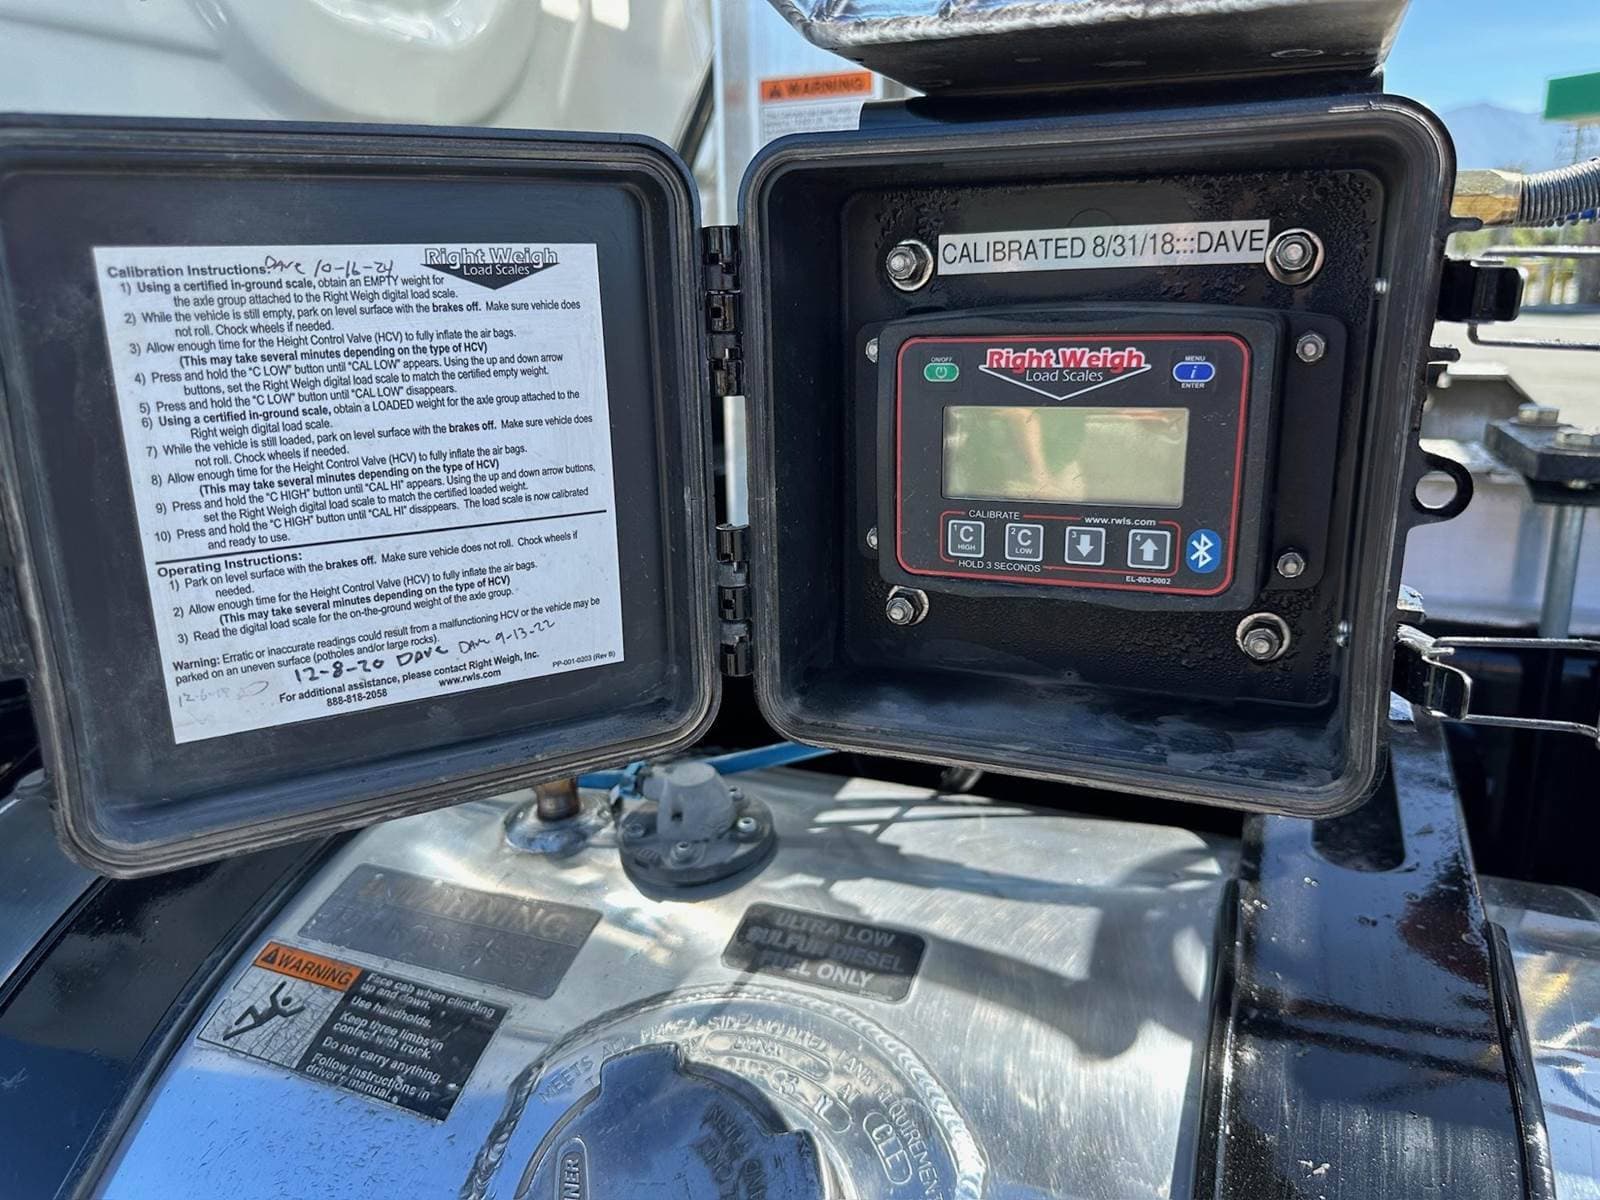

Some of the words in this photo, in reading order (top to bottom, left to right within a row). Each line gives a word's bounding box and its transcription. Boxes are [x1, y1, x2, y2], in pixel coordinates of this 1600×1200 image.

[788, 78, 864, 96] WARNING
[424, 247, 486, 269] Right
[489, 247, 559, 269] Weigh
[942, 237, 1086, 264] CALIBRATED
[106, 265, 184, 279] Calibration
[187, 262, 270, 277] Instructions:
[464, 264, 493, 276] Load
[496, 264, 530, 276] Scales
[173, 295, 191, 308] the
[192, 294, 215, 307] axle
[217, 296, 247, 309] group
[249, 292, 292, 305] attached
[293, 292, 304, 304] to
[305, 291, 321, 304] the
[323, 290, 349, 305] Right
[349, 289, 381, 304] Weigh
[381, 288, 409, 303] digital
[410, 288, 431, 300] load
[432, 288, 459, 299] scale.
[174, 325, 193, 337] not
[194, 324, 214, 337] roll.
[215, 323, 249, 336] Chock
[249, 321, 286, 334] wheels
[286, 321, 294, 333] if
[295, 319, 335, 333] needed.
[179, 354, 208, 370] (This
[209, 356, 233, 367] may
[234, 352, 258, 364] take
[260, 349, 299, 363] several
[300, 348, 342, 361] minutes
[342, 345, 396, 360] depending
[396, 345, 411, 356] on
[411, 343, 428, 355] the
[429, 343, 451, 357] type
[451, 342, 463, 354] of
[463, 341, 488, 354] HCV)
[986, 348, 1056, 374] Right
[1057, 347, 1146, 374] Weigh
[1025, 369, 1059, 382] Load
[1062, 369, 1104, 382] Scales
[190, 426, 218, 441] Right
[219, 424, 250, 438] weigh
[251, 421, 281, 437] digital
[281, 419, 303, 433] load
[304, 418, 334, 431] scale.
[203, 511, 220, 523] set
[221, 510, 238, 521] the
[238, 506, 266, 521] Right
[266, 503, 299, 517] Weigh
[298, 499, 328, 515] digital
[328, 497, 350, 510] load
[350, 495, 376, 508] scale
[377, 494, 387, 505] to
[388, 491, 416, 504] match
[417, 490, 433, 501] the
[433, 486, 468, 500] certified
[468, 482, 498, 496] loaded
[499, 481, 529, 493] weight.
[968, 509, 1020, 520] CALIBRATE
[953, 524, 958, 532] 1
[960, 525, 974, 542] C
[1084, 516, 1156, 526] www.rwls.com
[957, 544, 976, 552] HIGH
[1017, 529, 1032, 546] C
[1015, 547, 1033, 555] LOW
[157, 562, 222, 579] Operating
[224, 552, 303, 570] Instructions:
[958, 560, 985, 569] HOLD
[986, 562, 992, 570] 3
[993, 562, 1041, 573] SECONDS
[172, 657, 221, 672] Warning:
[222, 650, 255, 664] Erratic
[255, 650, 266, 659] or
[267, 641, 316, 658] inaccurate
[317, 636, 357, 649] readings
[357, 629, 383, 643] could
[383, 626, 409, 639] result
[409, 624, 430, 635] from
[431, 623, 438, 631] a
[439, 613, 499, 630] malfunctioning
[500, 608, 520, 621] HCV
[520, 609, 530, 617] or
[530, 606, 544, 616] the
[544, 601, 572, 613] vehicle
[573, 600, 589, 609] may
[590, 597, 600, 606] be
[175, 669, 210, 687] parked
[211, 669, 224, 679] on
[226, 667, 239, 676] an
[240, 661, 276, 674] uneven
[277, 655, 312, 668] surface
[312, 647, 355, 665] (potholes
[356, 642, 385, 655] and/or
[386, 639, 409, 651] large
[410, 633, 440, 647] rocks).
[294, 658, 385, 684] 12-8-20
[279, 692, 297, 703] For
[298, 683, 346, 700] additional
[347, 676, 401, 692] assistance,
[402, 670, 432, 684] please
[433, 662, 468, 676] contact
[468, 658, 493, 671] Right
[493, 653, 523, 666] Weigh,
[524, 651, 540, 660] Inc.
[438, 669, 502, 688] www.rwls.com
[326, 688, 388, 707] 888-818-2058
[776, 912, 840, 936] ULTRA
[844, 924, 897, 947] LOW
[746, 926, 830, 956] SULFUR
[829, 945, 904, 972] DIESEL
[278, 953, 353, 985] WARNING
[759, 950, 811, 977] FUEL
[816, 963, 875, 988] ONLY
[360, 983, 376, 996] up
[374, 986, 398, 999] and
[399, 991, 432, 1009] down.
[367, 973, 393, 988] Face
[394, 981, 415, 994] cab
[415, 988, 446, 1003] when
[447, 997, 496, 1018] climbing
[351, 995, 371, 1009] Use
[372, 1001, 433, 1029] handholds.
[333, 1022, 377, 1041] contact
[377, 1035, 403, 1051] with
[400, 1043, 433, 1060] truck.
[340, 1011, 369, 1028] Keep
[369, 1020, 399, 1036] three
[400, 1028, 429, 1046] limbs
[431, 1038, 445, 1051] in
[322, 1036, 338, 1050] Do
[340, 1043, 359, 1057] not
[360, 1050, 391, 1069] carry
[390, 1060, 443, 1085] anything.
[312, 1053, 353, 1071] Follow
[350, 1066, 417, 1095] instructions
[418, 1087, 431, 1101] in
[349, 1078, 392, 1101] manual.
[539, 1055, 596, 1104] MEETS
